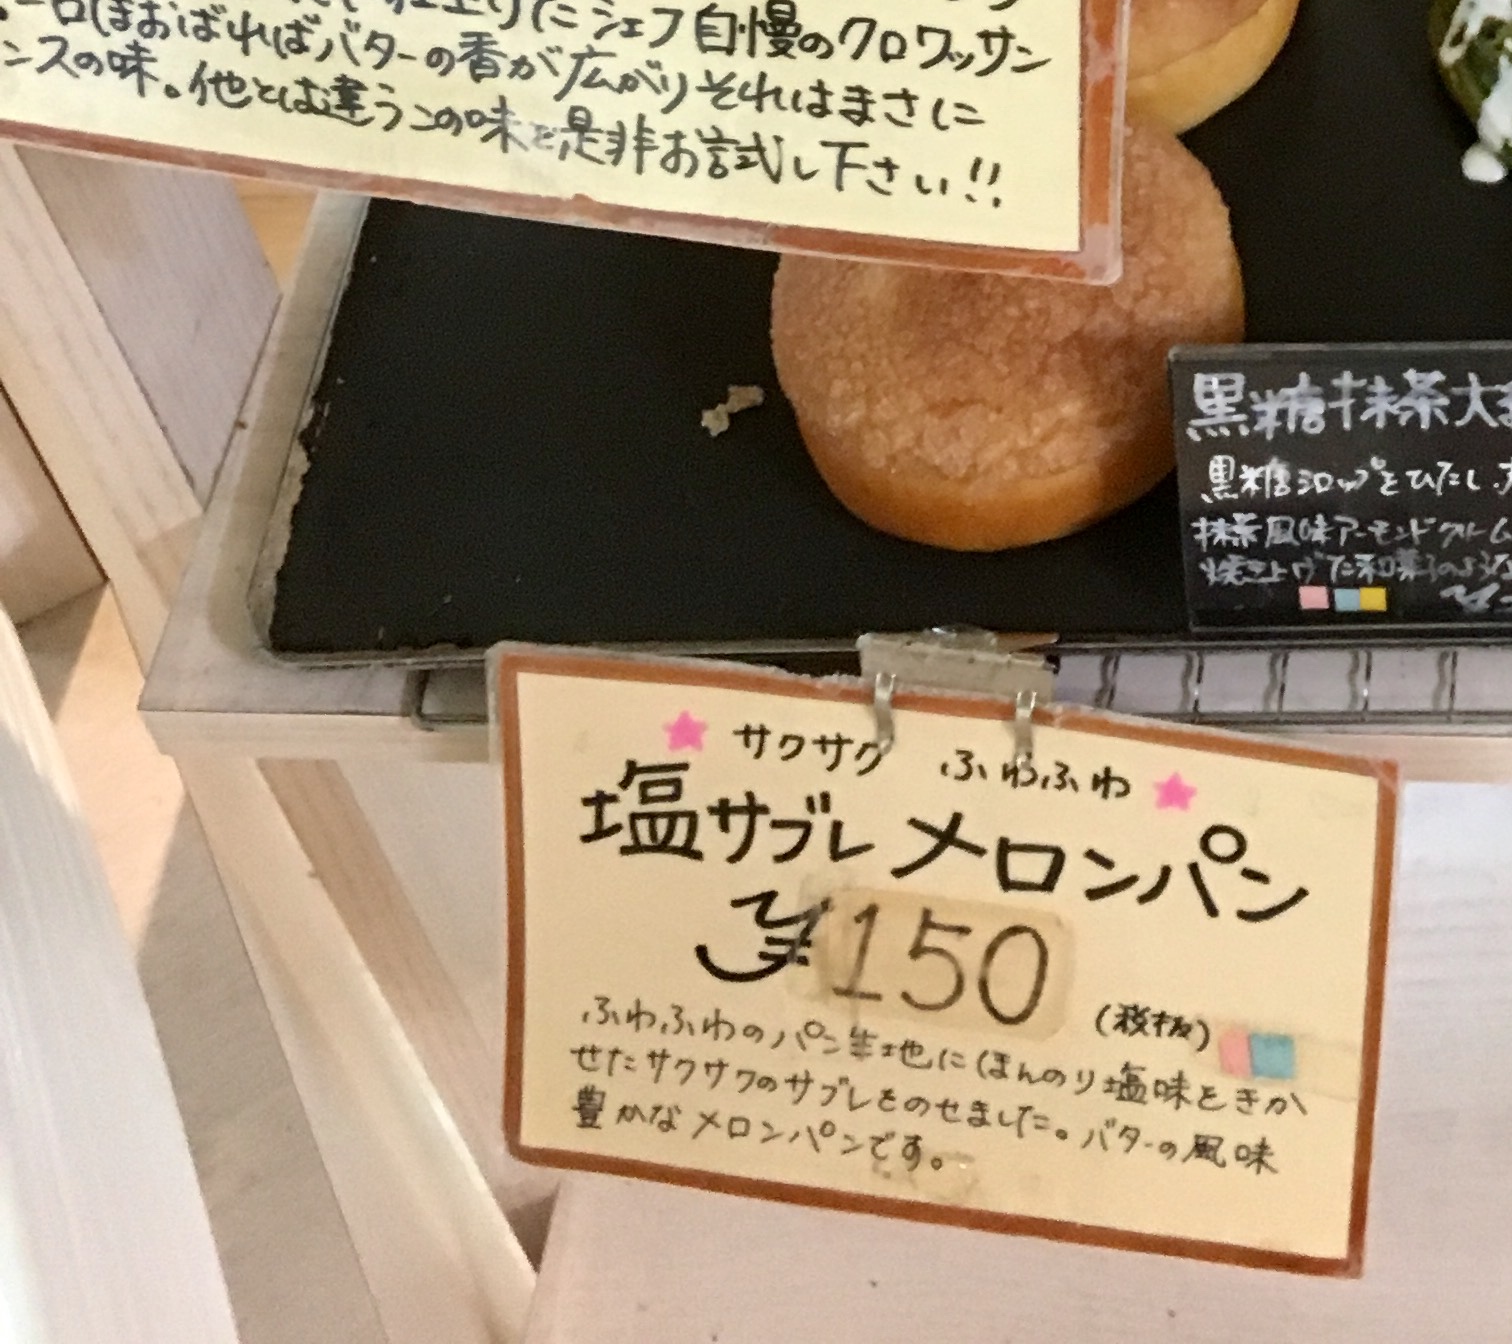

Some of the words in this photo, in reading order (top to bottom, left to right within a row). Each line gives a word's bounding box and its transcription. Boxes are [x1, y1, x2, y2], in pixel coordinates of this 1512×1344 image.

[734, 722, 884, 775] サクサク
[939, 749, 1131, 800] ふわふわ
[696, 890, 1049, 1027] ¥150
